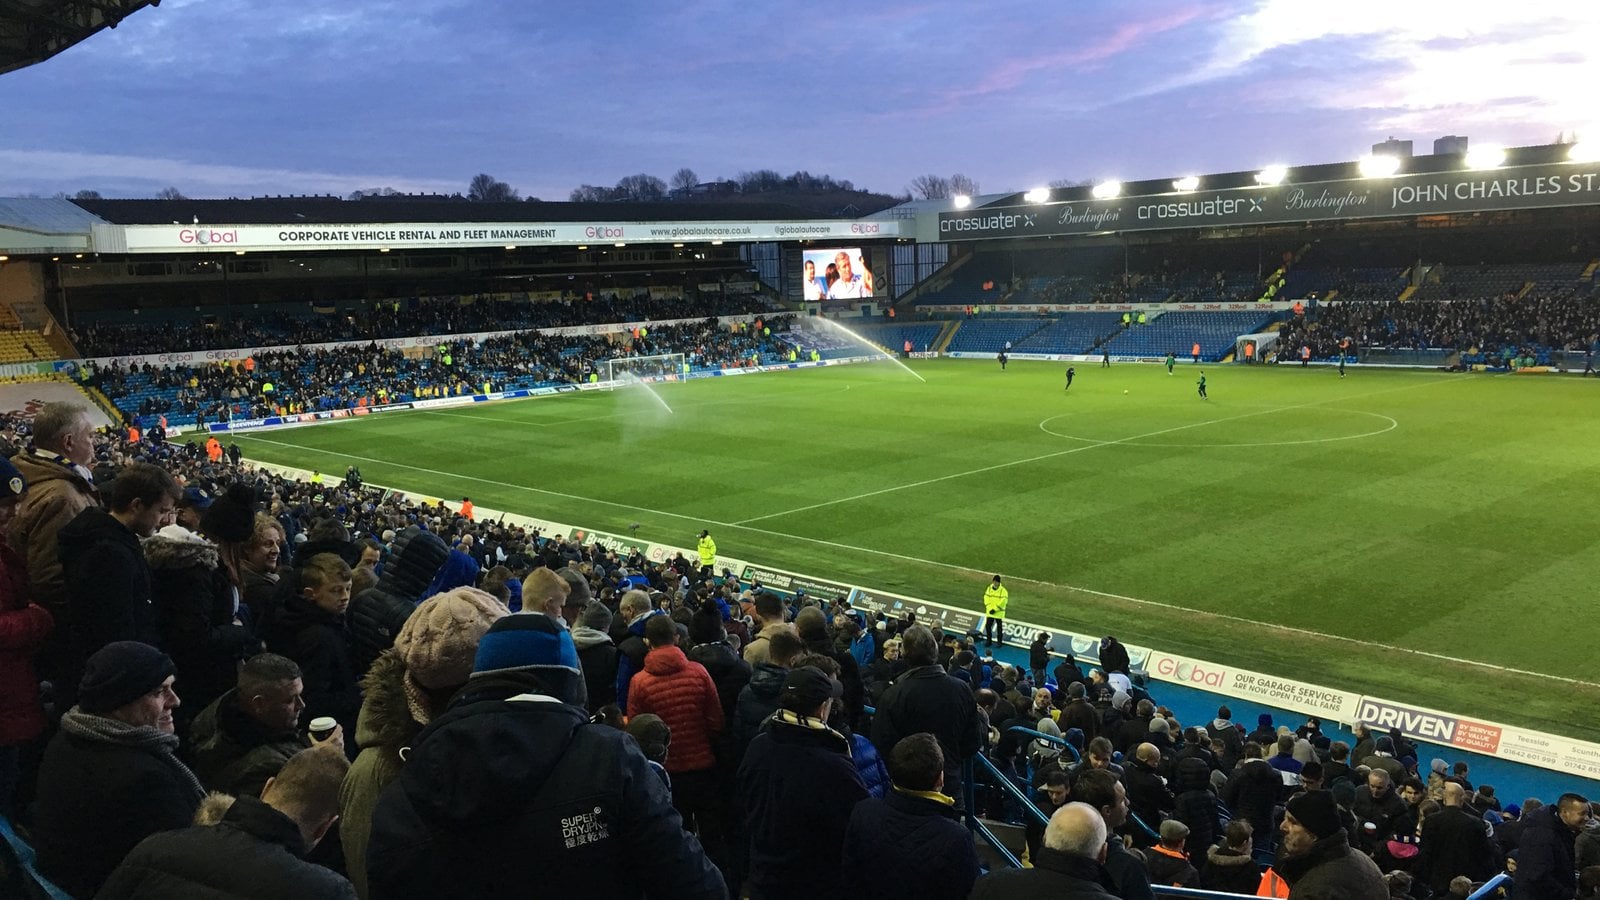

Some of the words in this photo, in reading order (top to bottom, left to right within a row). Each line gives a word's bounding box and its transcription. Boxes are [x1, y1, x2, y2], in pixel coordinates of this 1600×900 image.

[1391, 183, 1448, 209] JOHN
[1454, 175, 1562, 200] CHARLES
[1568, 173, 1600, 193] ST
[1137, 195, 1245, 220] crosswater
[851, 223, 880, 234] Global
[940, 212, 1021, 232] crosswater
[179, 229, 238, 244] Global
[278, 231, 349, 242] CORPORATE
[351, 230, 396, 241] VEHICLE
[399, 229, 436, 240] RENTAL
[439, 229, 461, 240] AND
[464, 229, 488, 239] FLEET
[490, 228, 556, 239] MANAGEMENT
[585, 226, 624, 239] Global
[650, 226, 751, 237] www.globalautocare.co.uk
[774, 225, 831, 236] @globalautocare
[158, 352, 193, 363] Global
[1157, 657, 1226, 689] Global
[1235, 673, 1255, 684] OUR
[1257, 678, 1296, 694] GARAGE
[1298, 687, 1344, 705] SERVICES
[1232, 681, 1247, 690] ARE
[1248, 684, 1267, 695] NOW
[1269, 690, 1291, 700] OPEN
[1292, 695, 1303, 703] TO
[1303, 698, 1318, 707] ALL
[1319, 701, 1341, 712] FANS
[1361, 703, 1455, 740] DRIVEN
[1468, 732, 1490, 742] VALUE
[1469, 726, 1498, 737] SERVICE
[1466, 739, 1497, 750] QUALITY
[1517, 735, 1550, 747] Teesside
